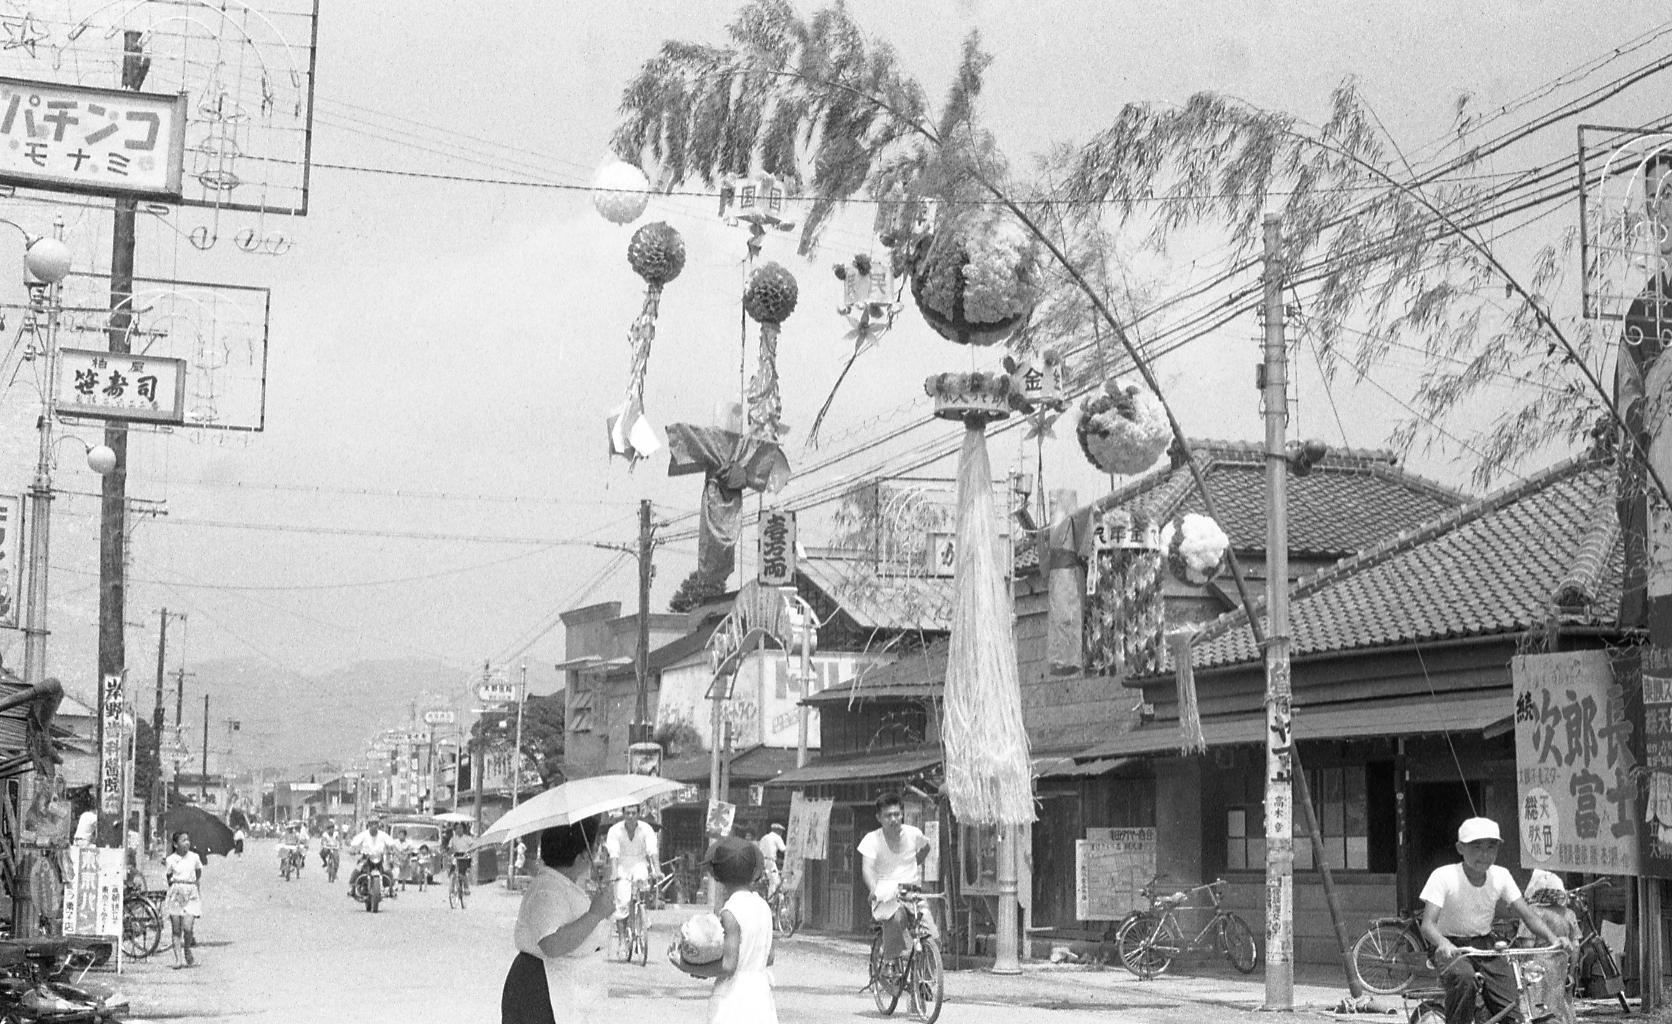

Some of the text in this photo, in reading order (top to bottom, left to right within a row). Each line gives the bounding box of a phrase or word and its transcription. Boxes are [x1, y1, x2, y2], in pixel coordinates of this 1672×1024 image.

[0, 95, 160, 151] パチンコ
[25, 142, 131, 176] モナミ
[74, 368, 158, 402] 笹寿司
[1023, 367, 1043, 391] 金
[1569, 768, 1638, 840] 富士
